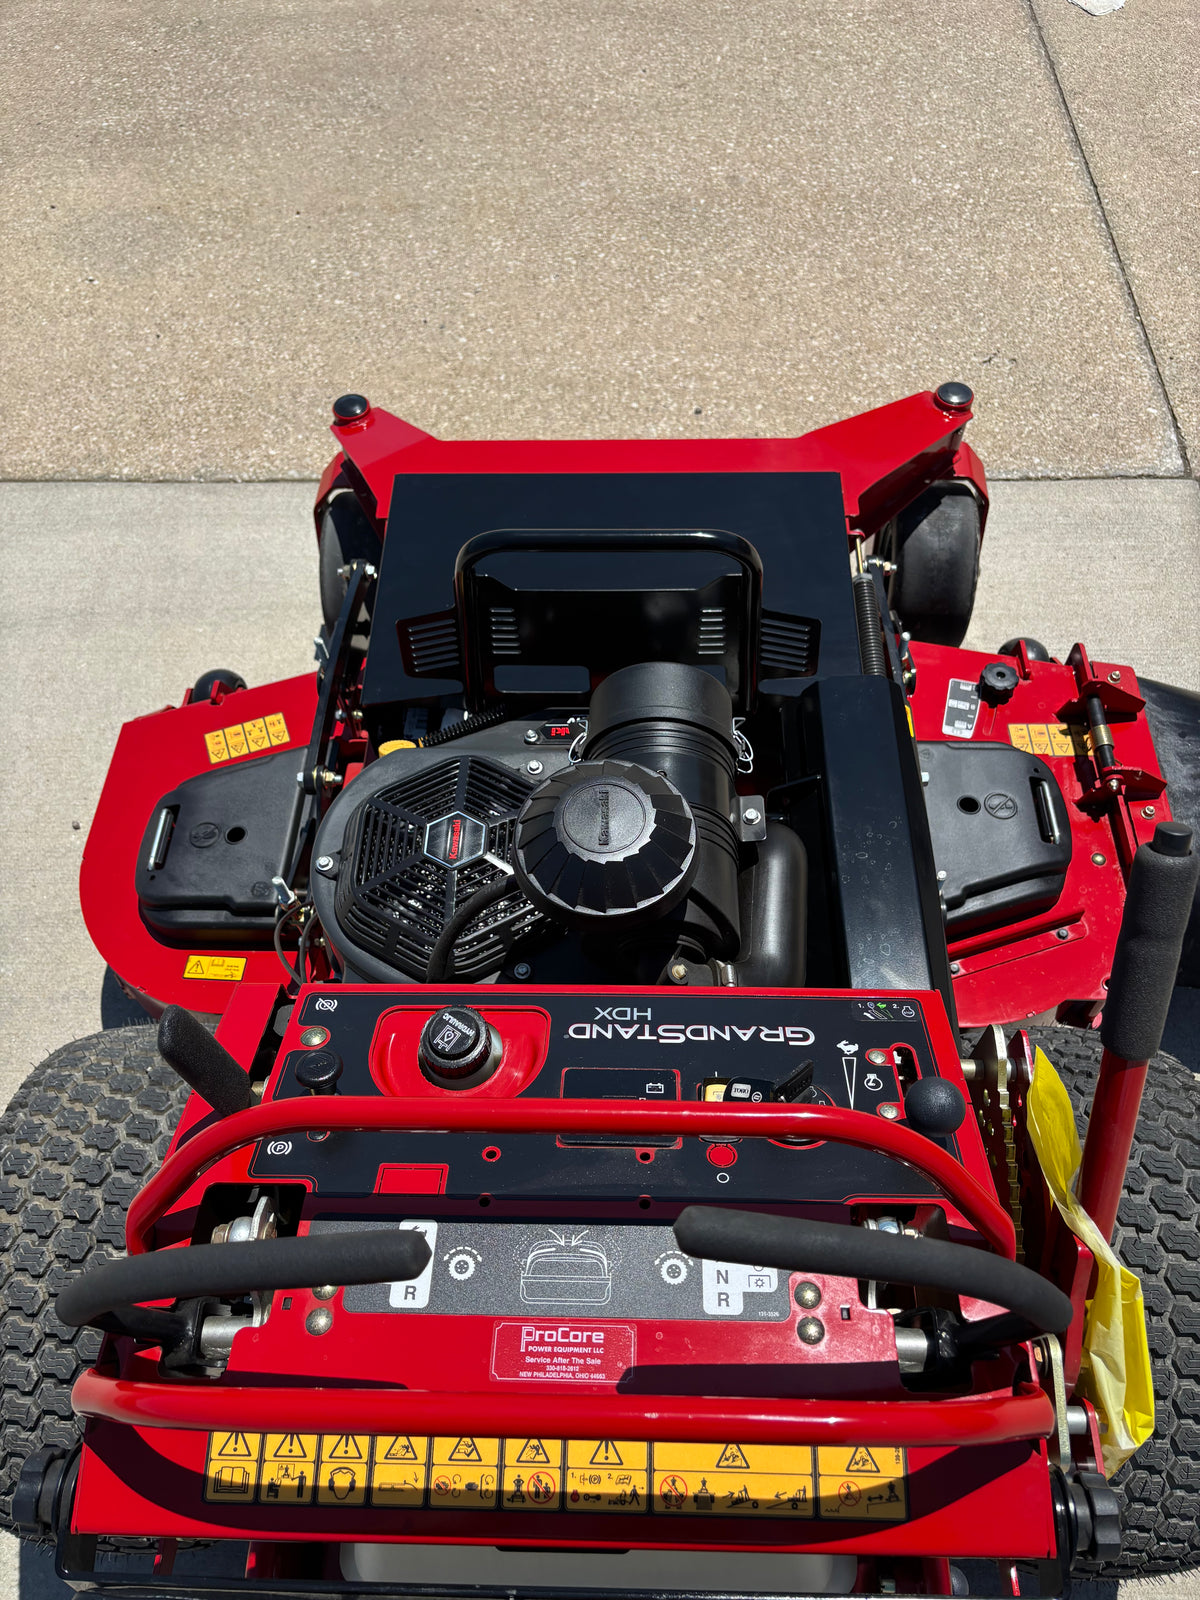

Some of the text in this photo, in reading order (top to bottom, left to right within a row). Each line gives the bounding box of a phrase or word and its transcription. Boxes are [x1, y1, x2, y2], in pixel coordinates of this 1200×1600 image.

[598, 789, 610, 846] Kawasaki
[448, 819, 461, 860] Kawasaki
[594, 1007, 652, 1021] HDX
[442, 1012, 475, 1037] HYDRAULIC
[716, 1269, 729, 1284] N
[404, 1285, 417, 1300] R
[718, 1292, 730, 1307] R
[520, 1326, 604, 1352] ProCore
[528, 1345, 552, 1353] POWER
[554, 1346, 592, 1354] EQUIPMENT
[525, 1356, 601, 1365] Service After The Sale
